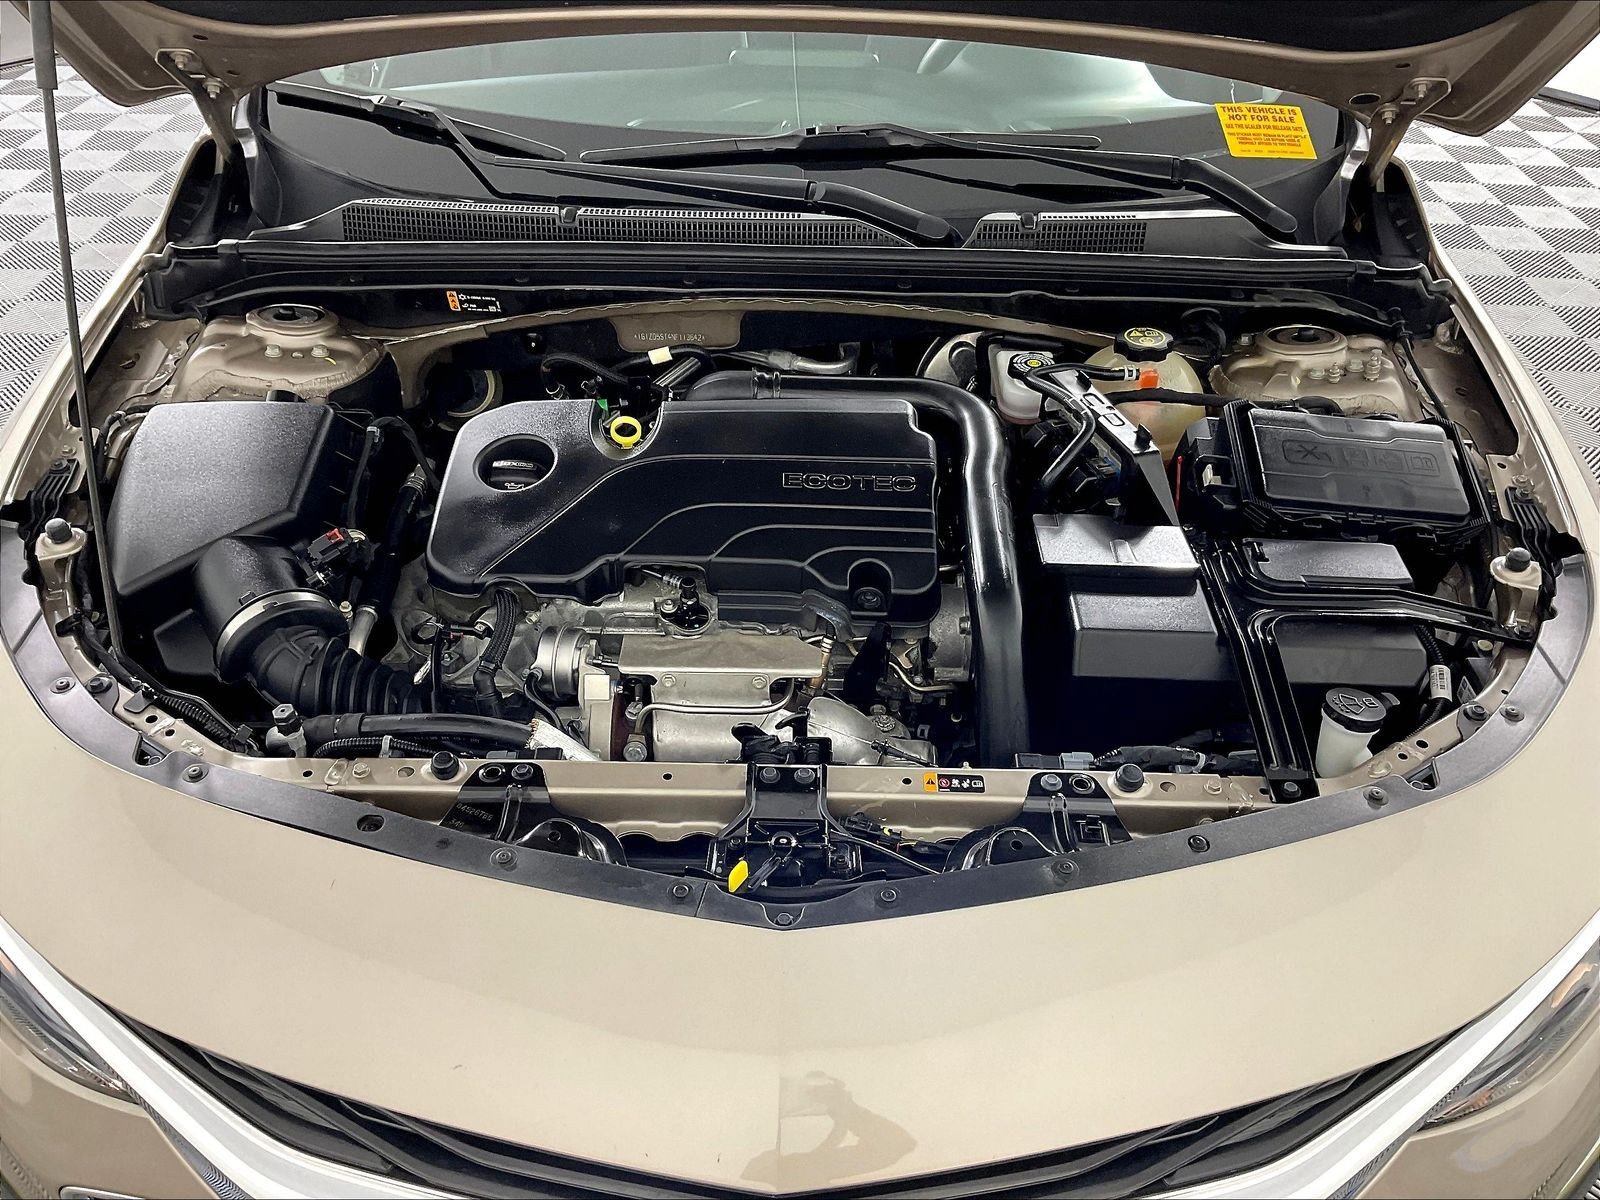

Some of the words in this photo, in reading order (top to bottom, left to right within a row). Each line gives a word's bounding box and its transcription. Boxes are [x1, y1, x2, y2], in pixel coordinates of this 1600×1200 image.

[1245, 106, 1286, 115] VEHICLE
[1287, 108, 1297, 116] IS
[1228, 113, 1248, 121] NOT
[1251, 114, 1271, 122] FOR
[1271, 115, 1296, 124] SALE
[782, 472, 917, 492] ECOTEC
